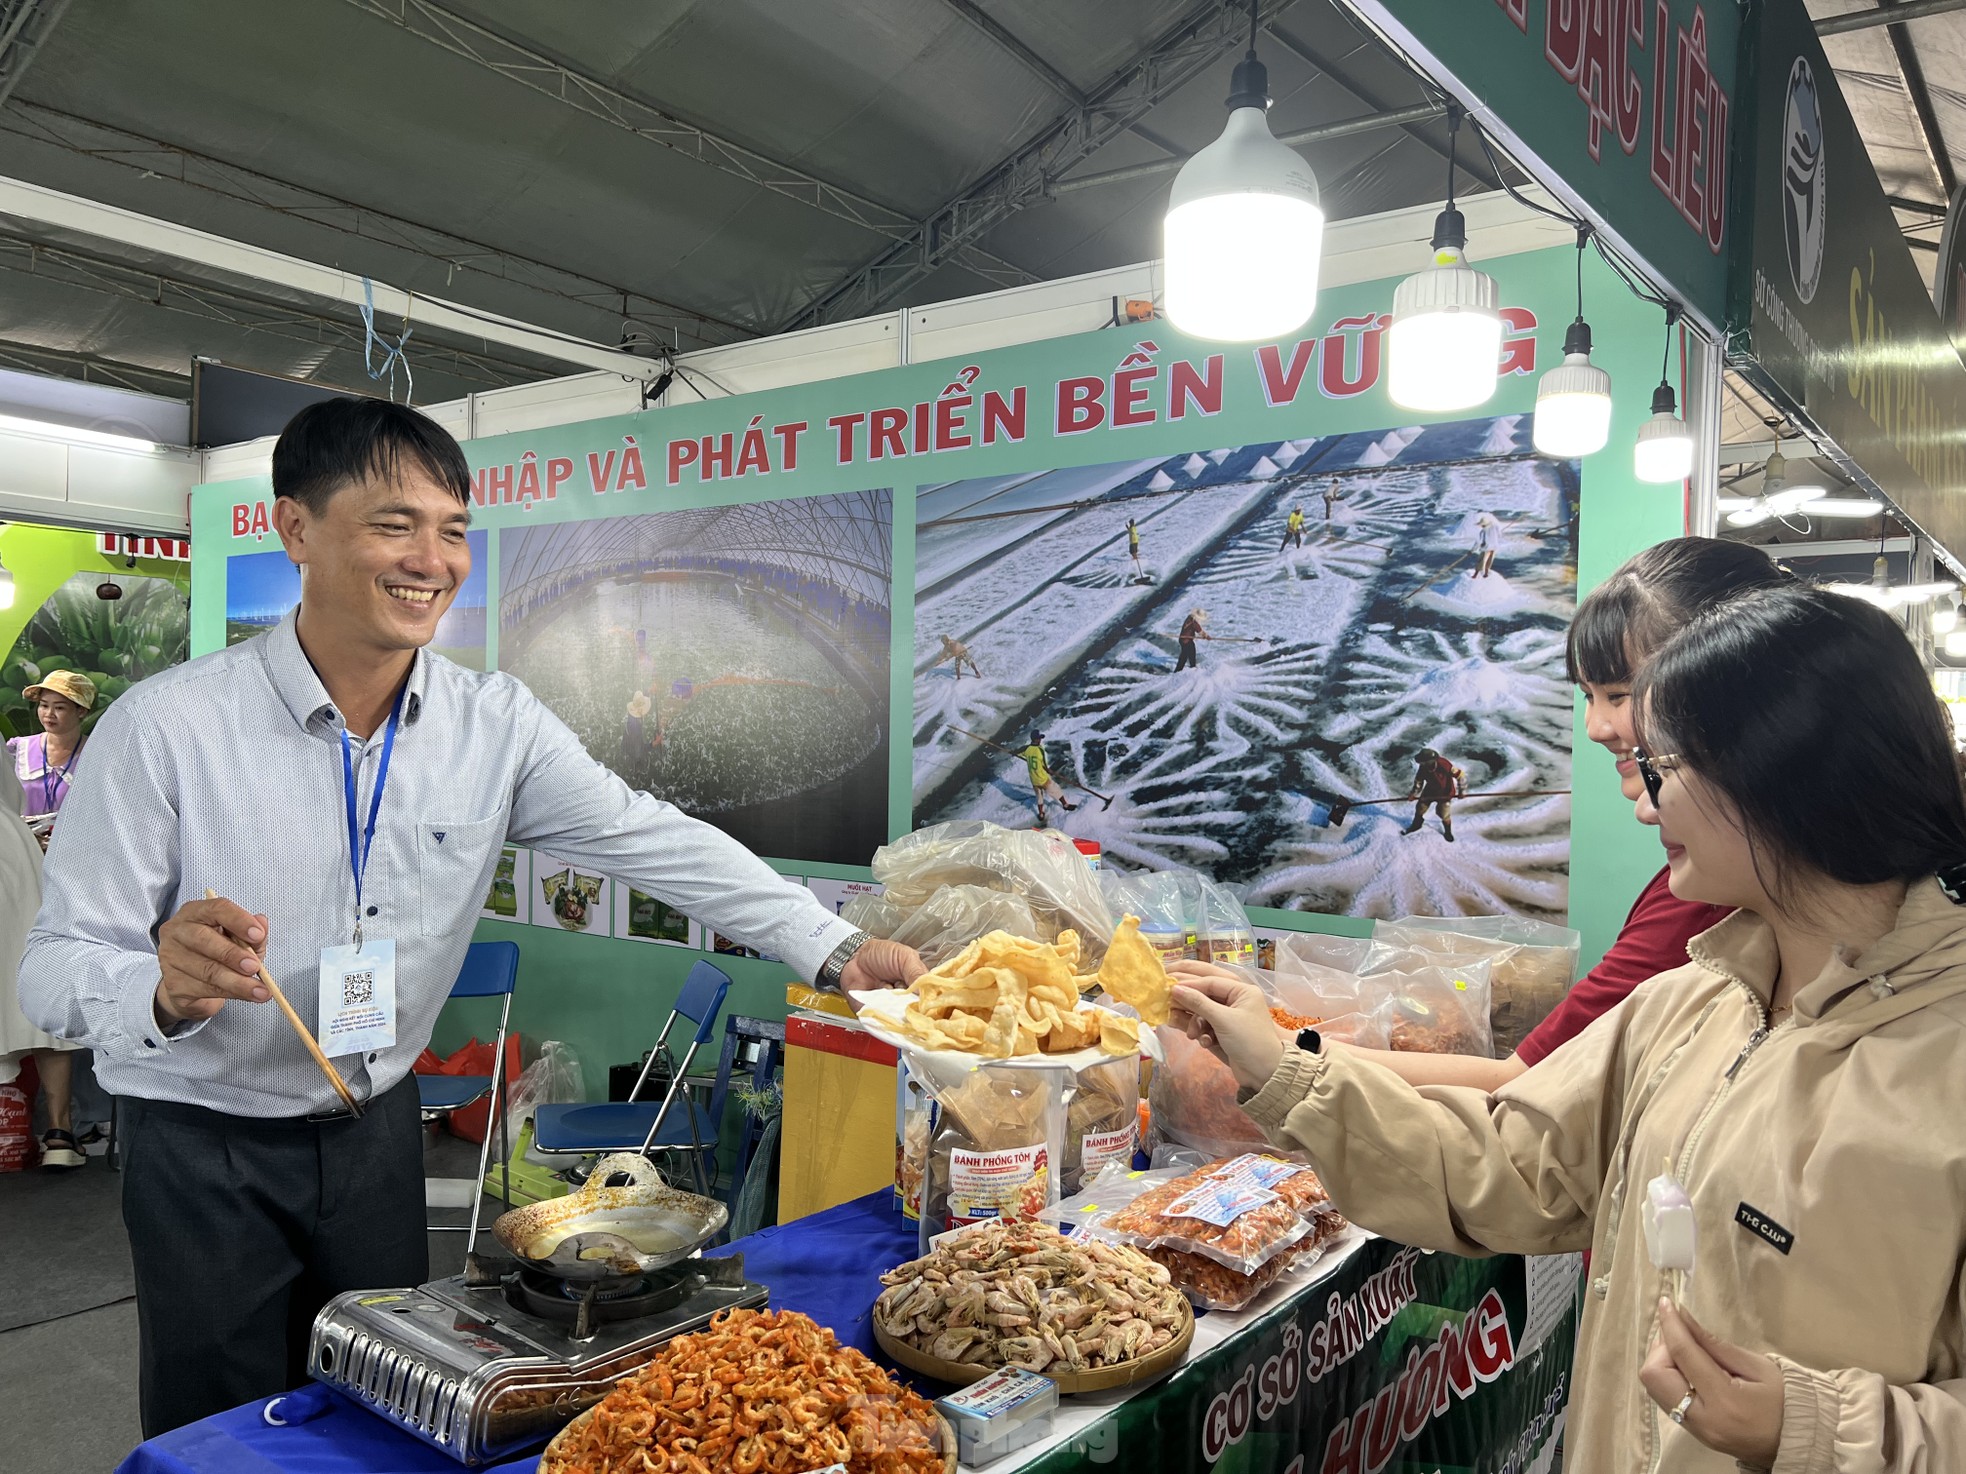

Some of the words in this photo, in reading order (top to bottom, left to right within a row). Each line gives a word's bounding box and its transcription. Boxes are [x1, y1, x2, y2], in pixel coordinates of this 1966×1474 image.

[1650, 0, 1728, 255] LIÊU
[232, 499, 274, 543] BẠ
[468, 449, 575, 512] NHẬP
[587, 435, 648, 496] VÀ
[667, 414, 808, 486] PHÁT
[826, 365, 1028, 466] TRIỂN
[1053, 340, 1225, 437] BỀN
[1253, 306, 1538, 409] VỮG
[953, 1153, 981, 1167] BÁNH
[1014, 1151, 1032, 1163] TÔM
[1202, 1363, 1256, 1464] CƠ
[1256, 1323, 1303, 1422] SỞ
[1306, 1291, 1364, 1385] SẢN
[1363, 1242, 1422, 1341] XUẤT
[1318, 1286, 1516, 1474] HƯƠNG
